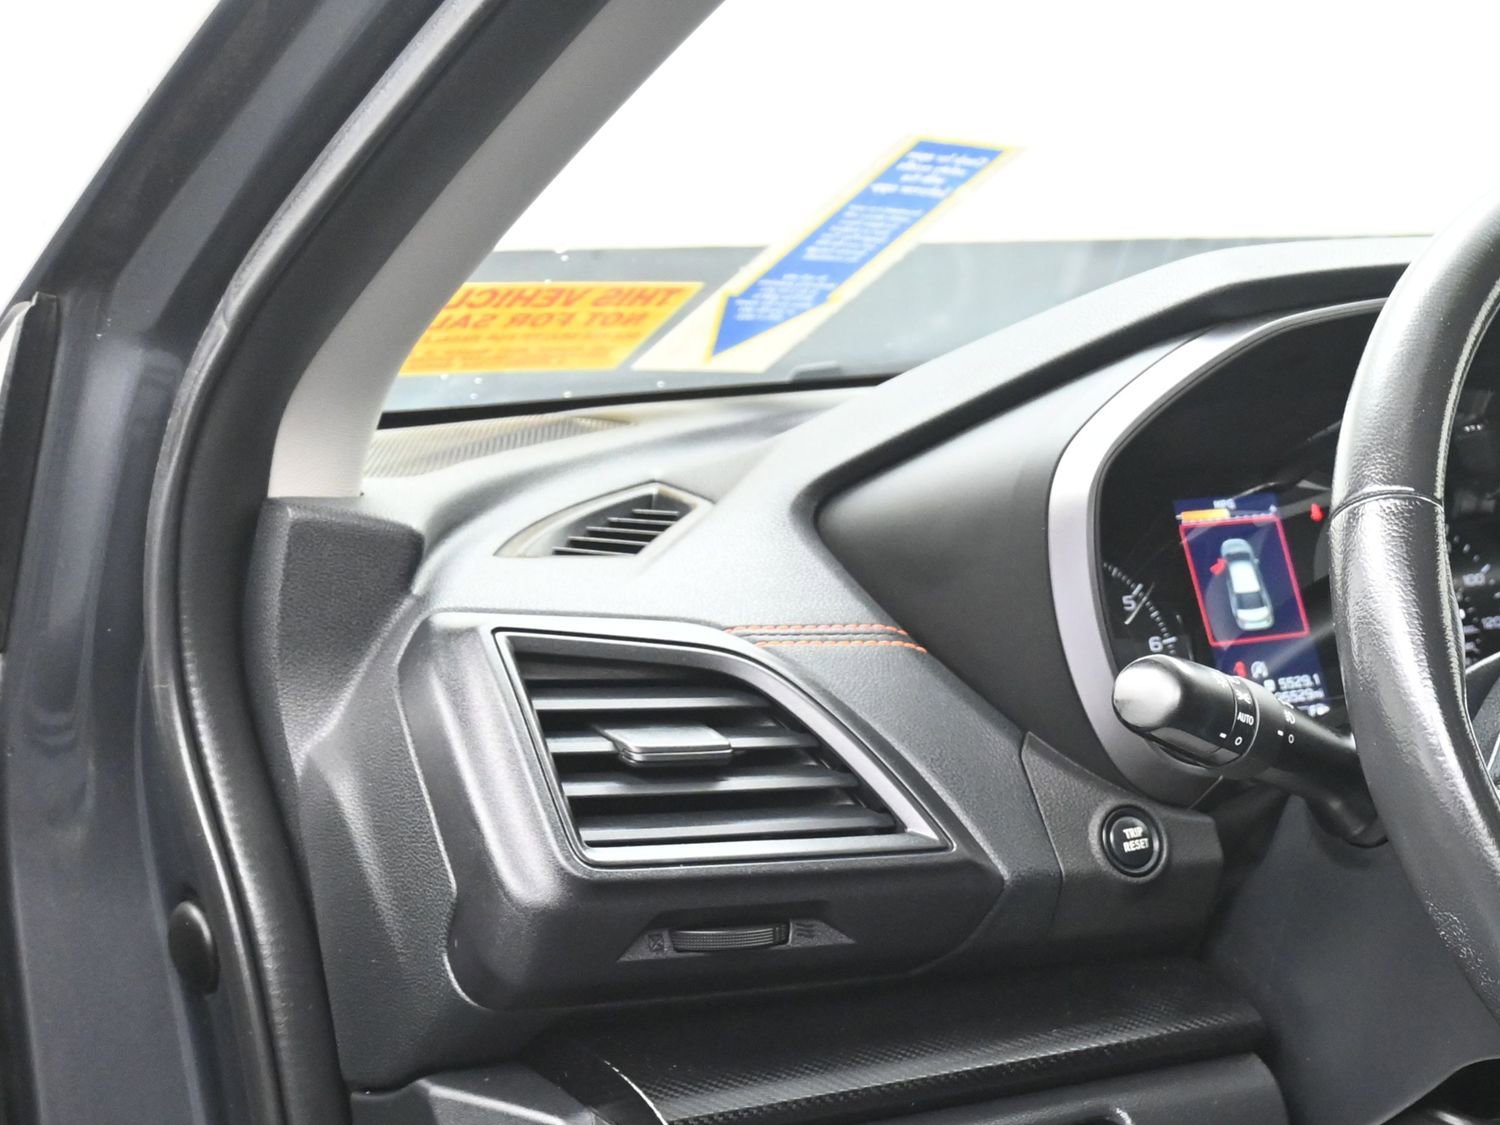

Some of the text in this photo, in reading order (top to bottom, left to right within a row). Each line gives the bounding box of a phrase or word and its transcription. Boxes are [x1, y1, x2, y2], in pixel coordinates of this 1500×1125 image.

[1121, 595, 1136, 611] 5
[1148, 636, 1163, 652] 6
[1237, 711, 1254, 726] AUTO
[1123, 826, 1143, 840] TRIP
[1123, 838, 1149, 853] RESET
